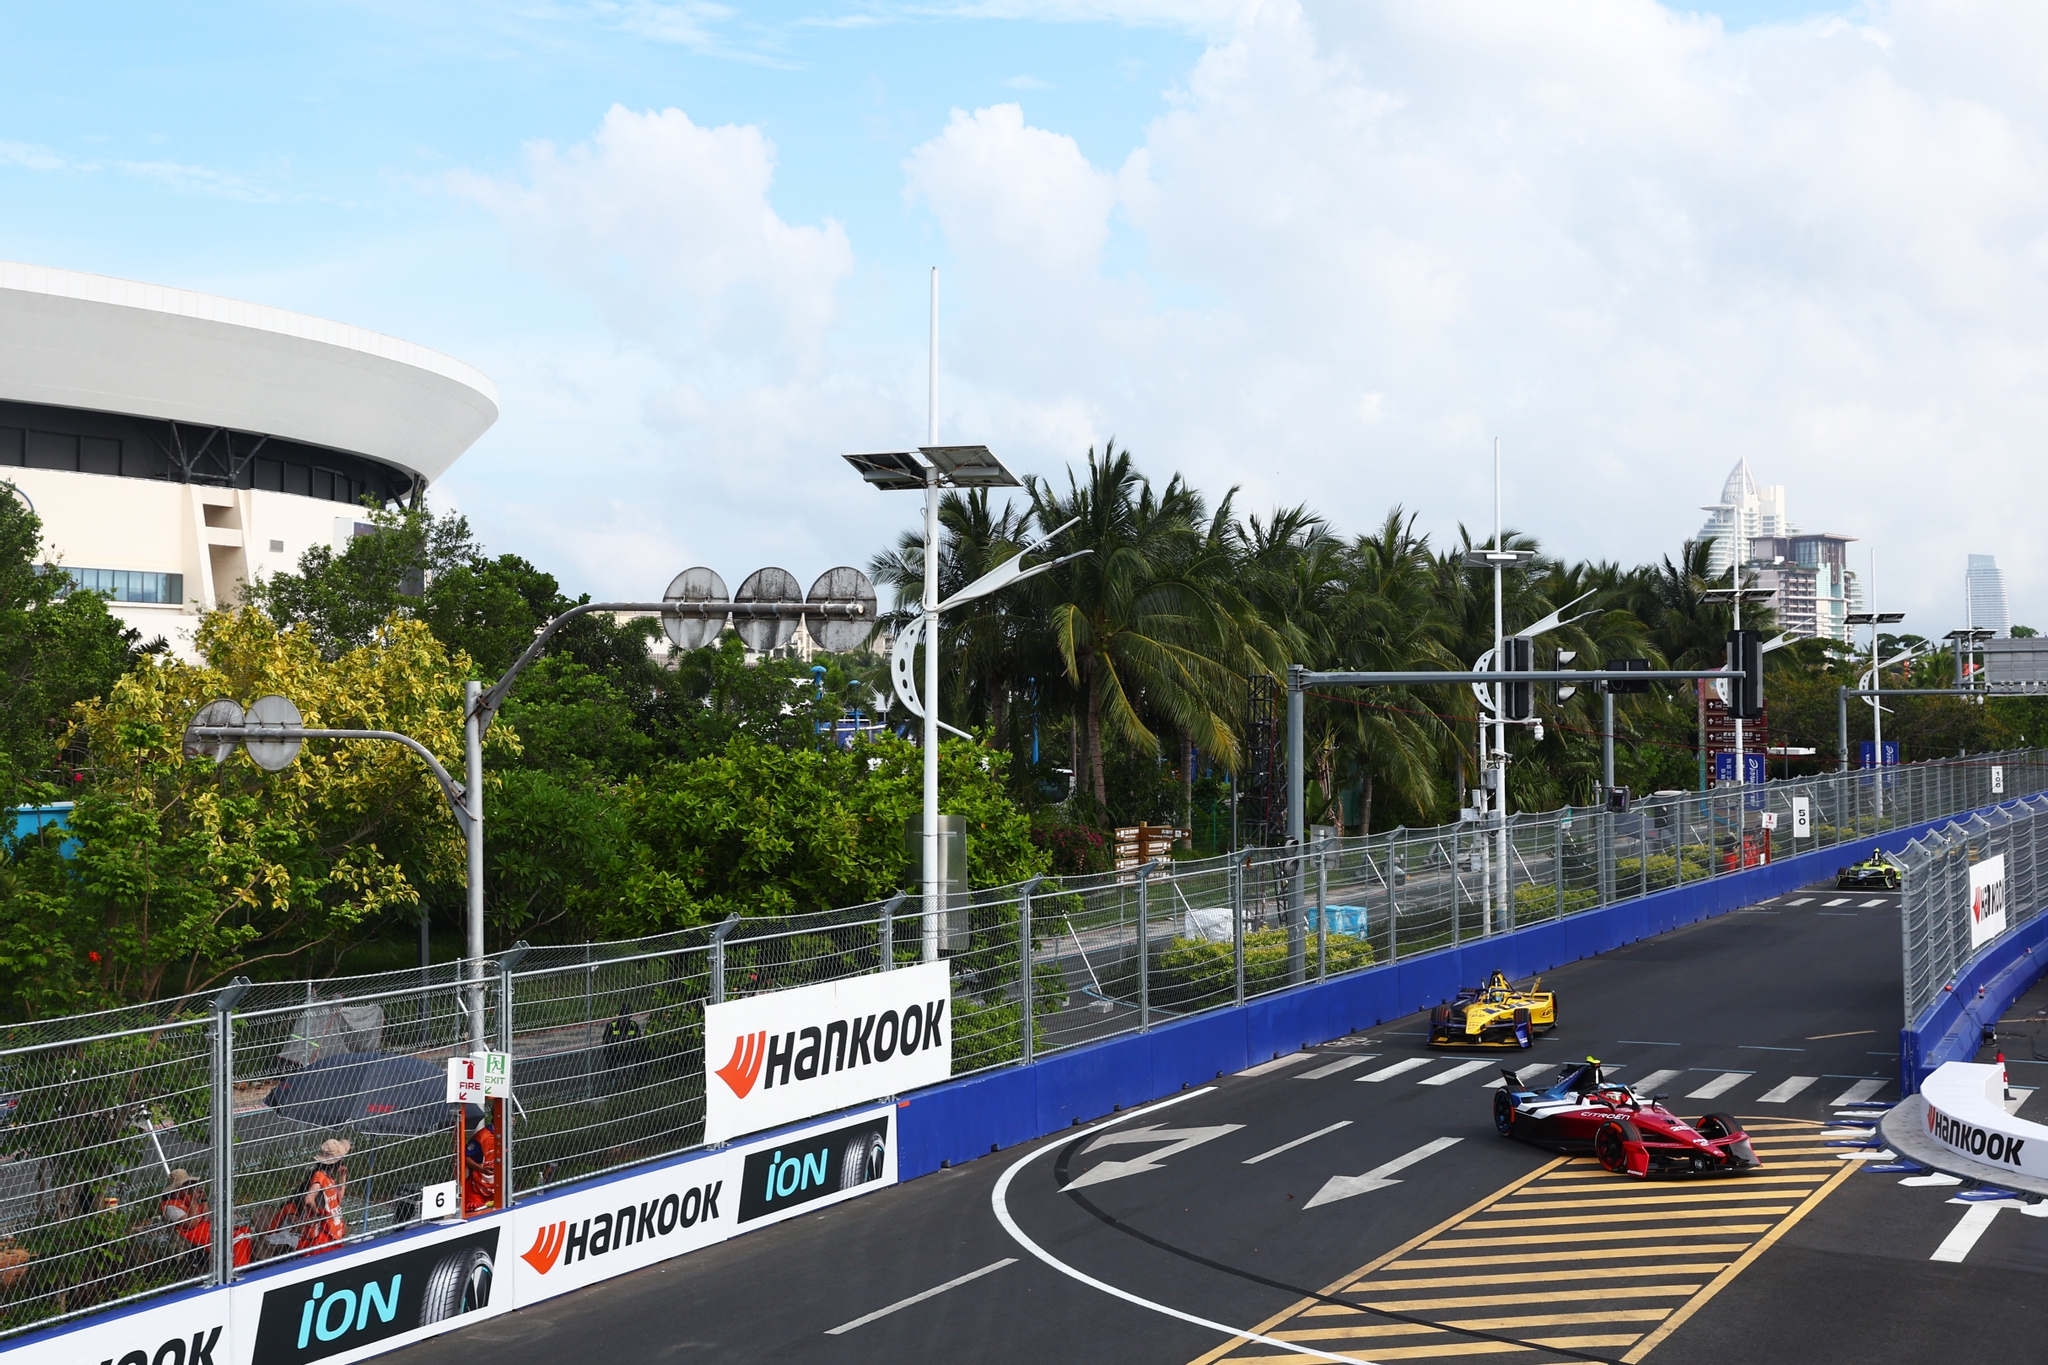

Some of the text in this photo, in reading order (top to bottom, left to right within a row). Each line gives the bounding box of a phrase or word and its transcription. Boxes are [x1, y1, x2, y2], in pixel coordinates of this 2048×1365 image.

[1798, 809, 1807, 826] 50
[459, 1081, 481, 1090] FIRE
[485, 1075, 505, 1085] EXIT
[436, 1193, 445, 1208] 6
